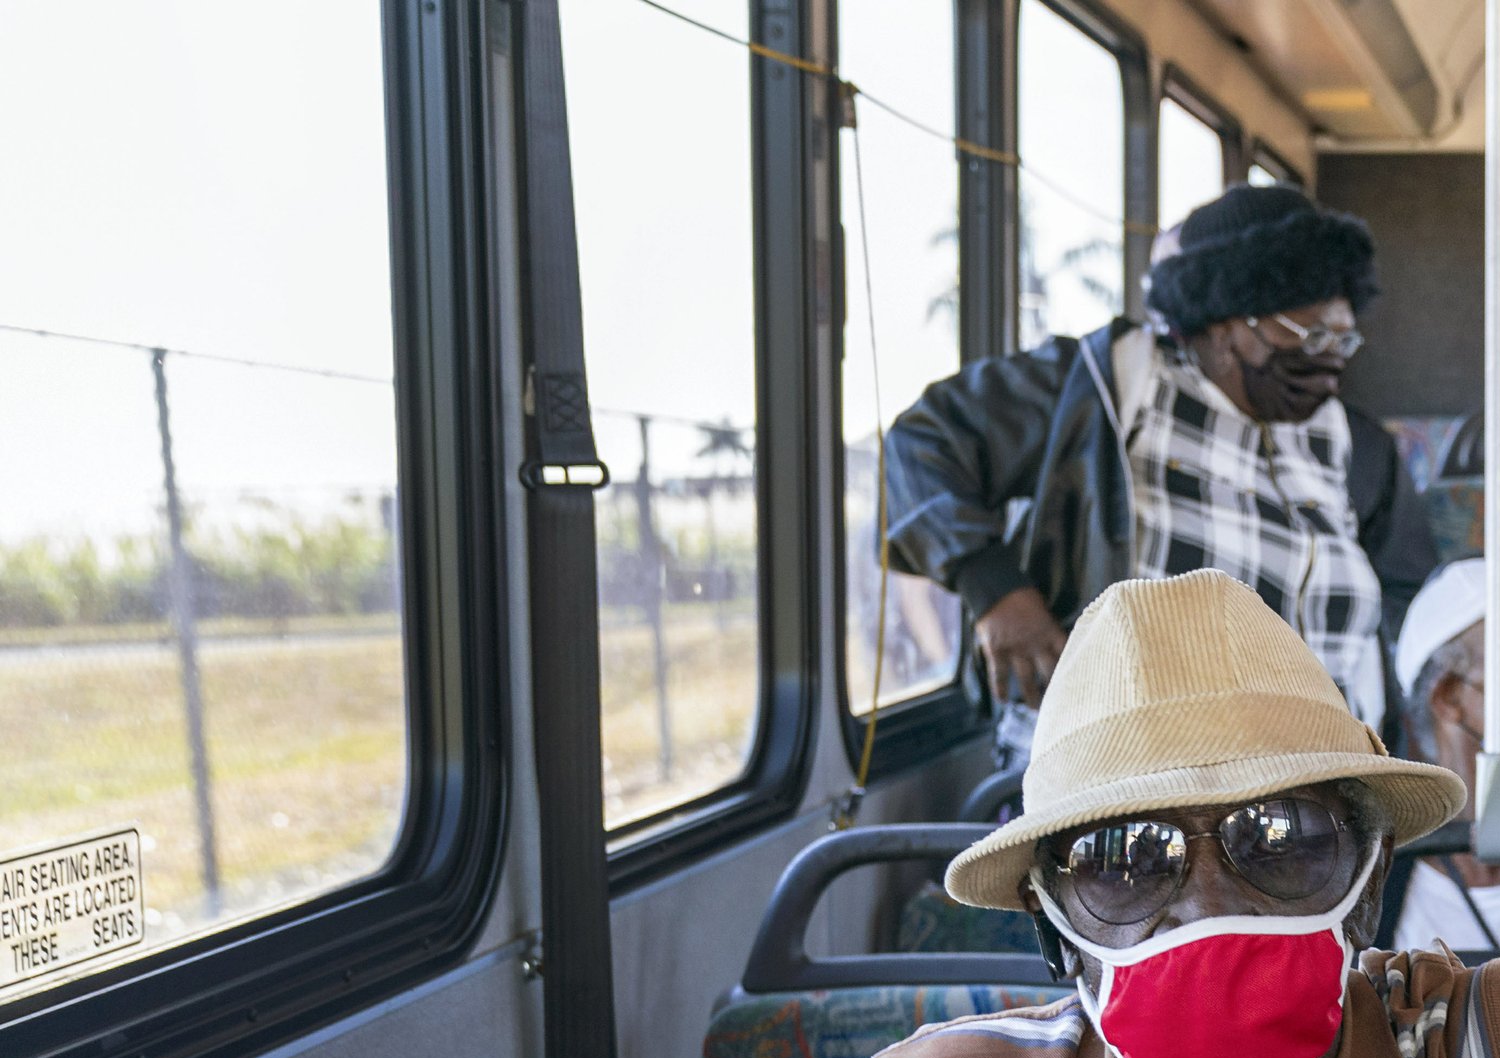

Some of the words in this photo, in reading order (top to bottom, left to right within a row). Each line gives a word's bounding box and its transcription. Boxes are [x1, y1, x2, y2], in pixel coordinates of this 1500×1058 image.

[30, 851, 90, 895] SEATING
[44, 893, 71, 927] ARE
[75, 875, 135, 918] LOCATED
[11, 932, 59, 974] THESE
